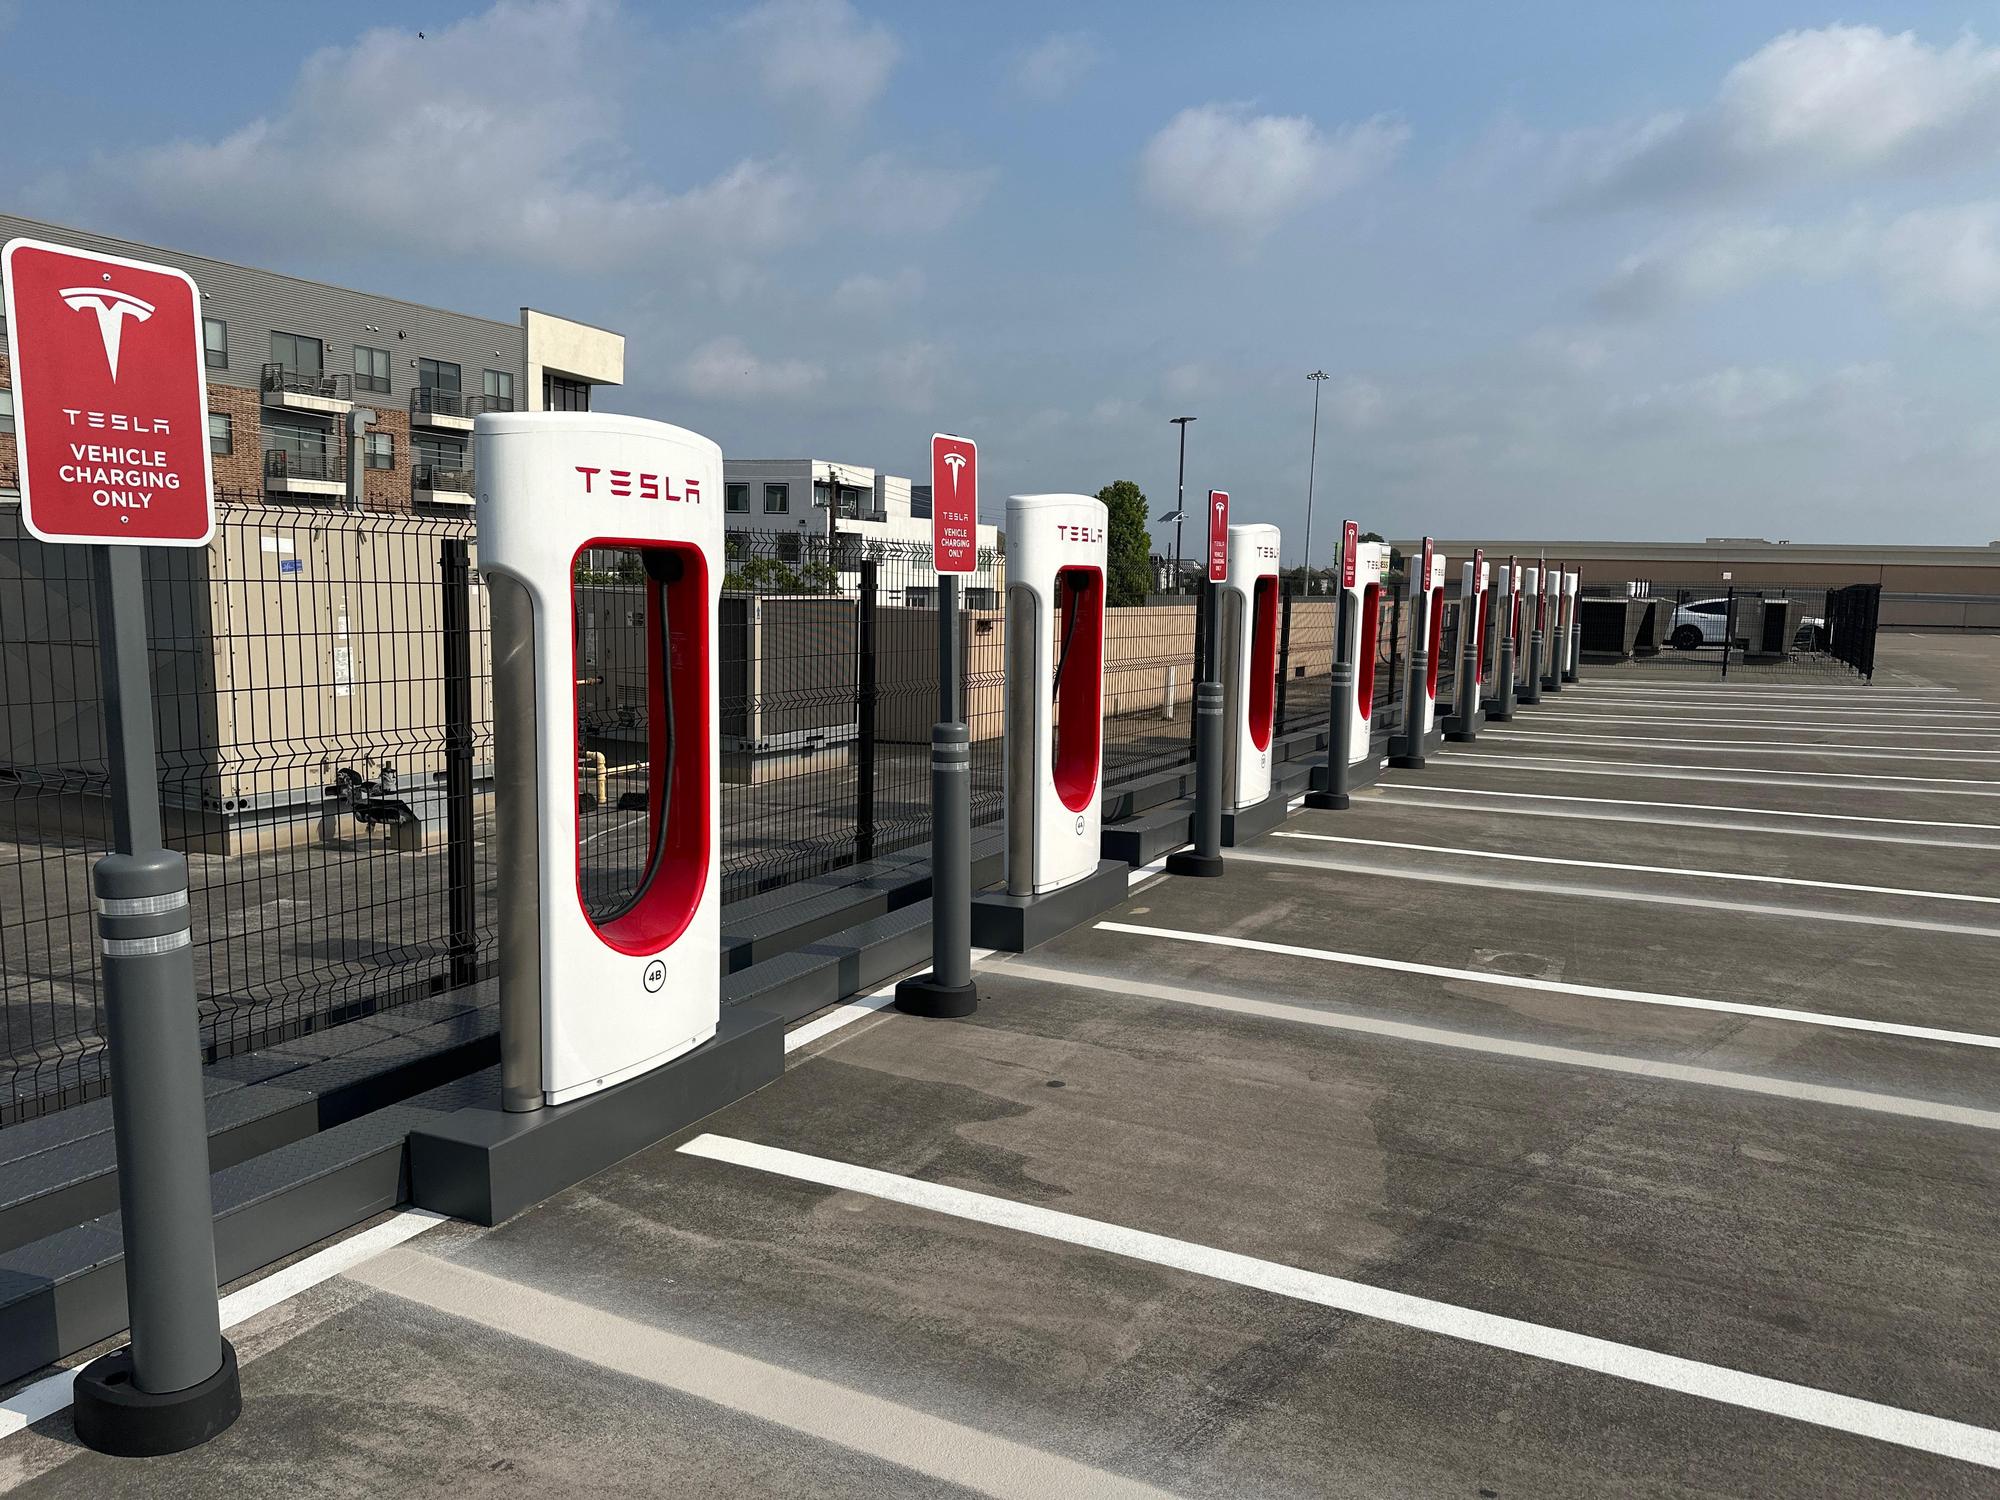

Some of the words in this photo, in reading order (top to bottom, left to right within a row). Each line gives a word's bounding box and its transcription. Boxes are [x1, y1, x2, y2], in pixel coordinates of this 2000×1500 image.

[62, 408, 170, 435] TESLA
[70, 443, 167, 467] VEHICLE
[59, 465, 180, 489] CHARGING
[574, 466, 700, 504] TESLA
[92, 489, 152, 508] ONLY
[943, 511, 969, 522] TESLA
[944, 528, 968, 538] VEHICLE
[1057, 525, 1103, 543] TESLA
[941, 538, 970, 548] CHARGING
[949, 549, 964, 558] ONLY
[648, 970, 661, 981] 4B
